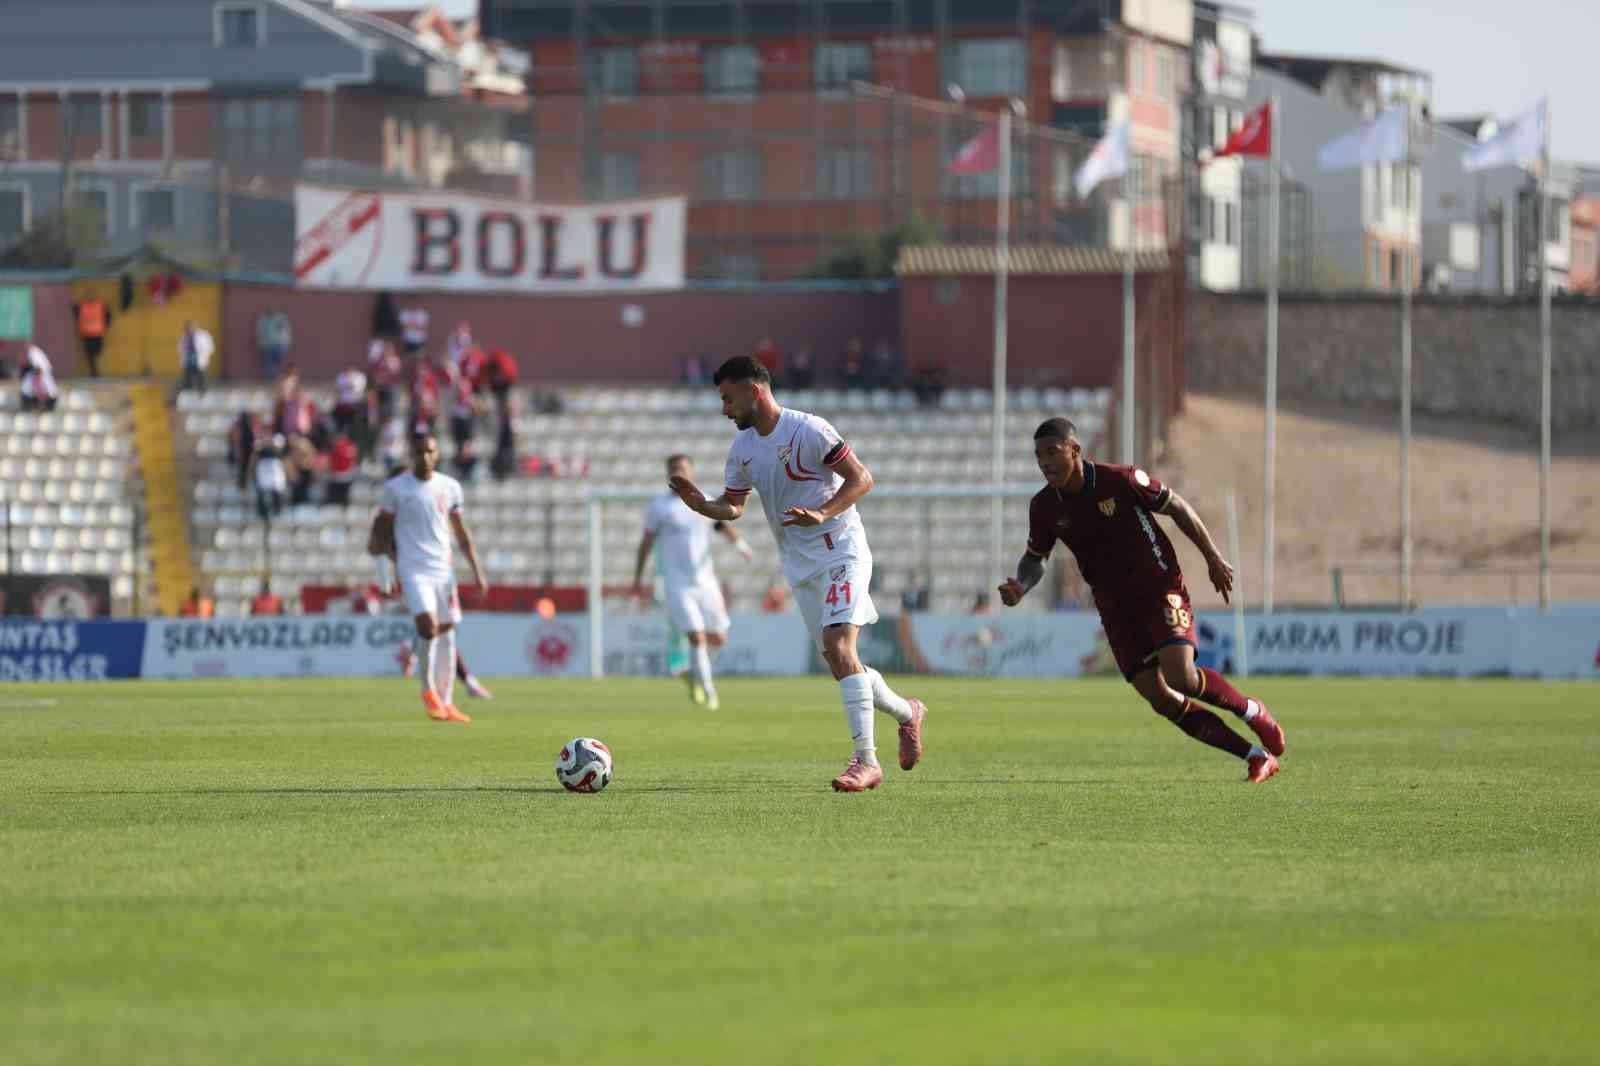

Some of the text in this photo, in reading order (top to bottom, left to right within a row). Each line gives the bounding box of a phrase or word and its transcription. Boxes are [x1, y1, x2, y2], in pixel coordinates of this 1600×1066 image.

[411, 207, 651, 279] BOLU
[825, 581, 851, 606] 41
[1164, 608, 1190, 629] 98
[1253, 620, 1466, 654] MRM PROJE
